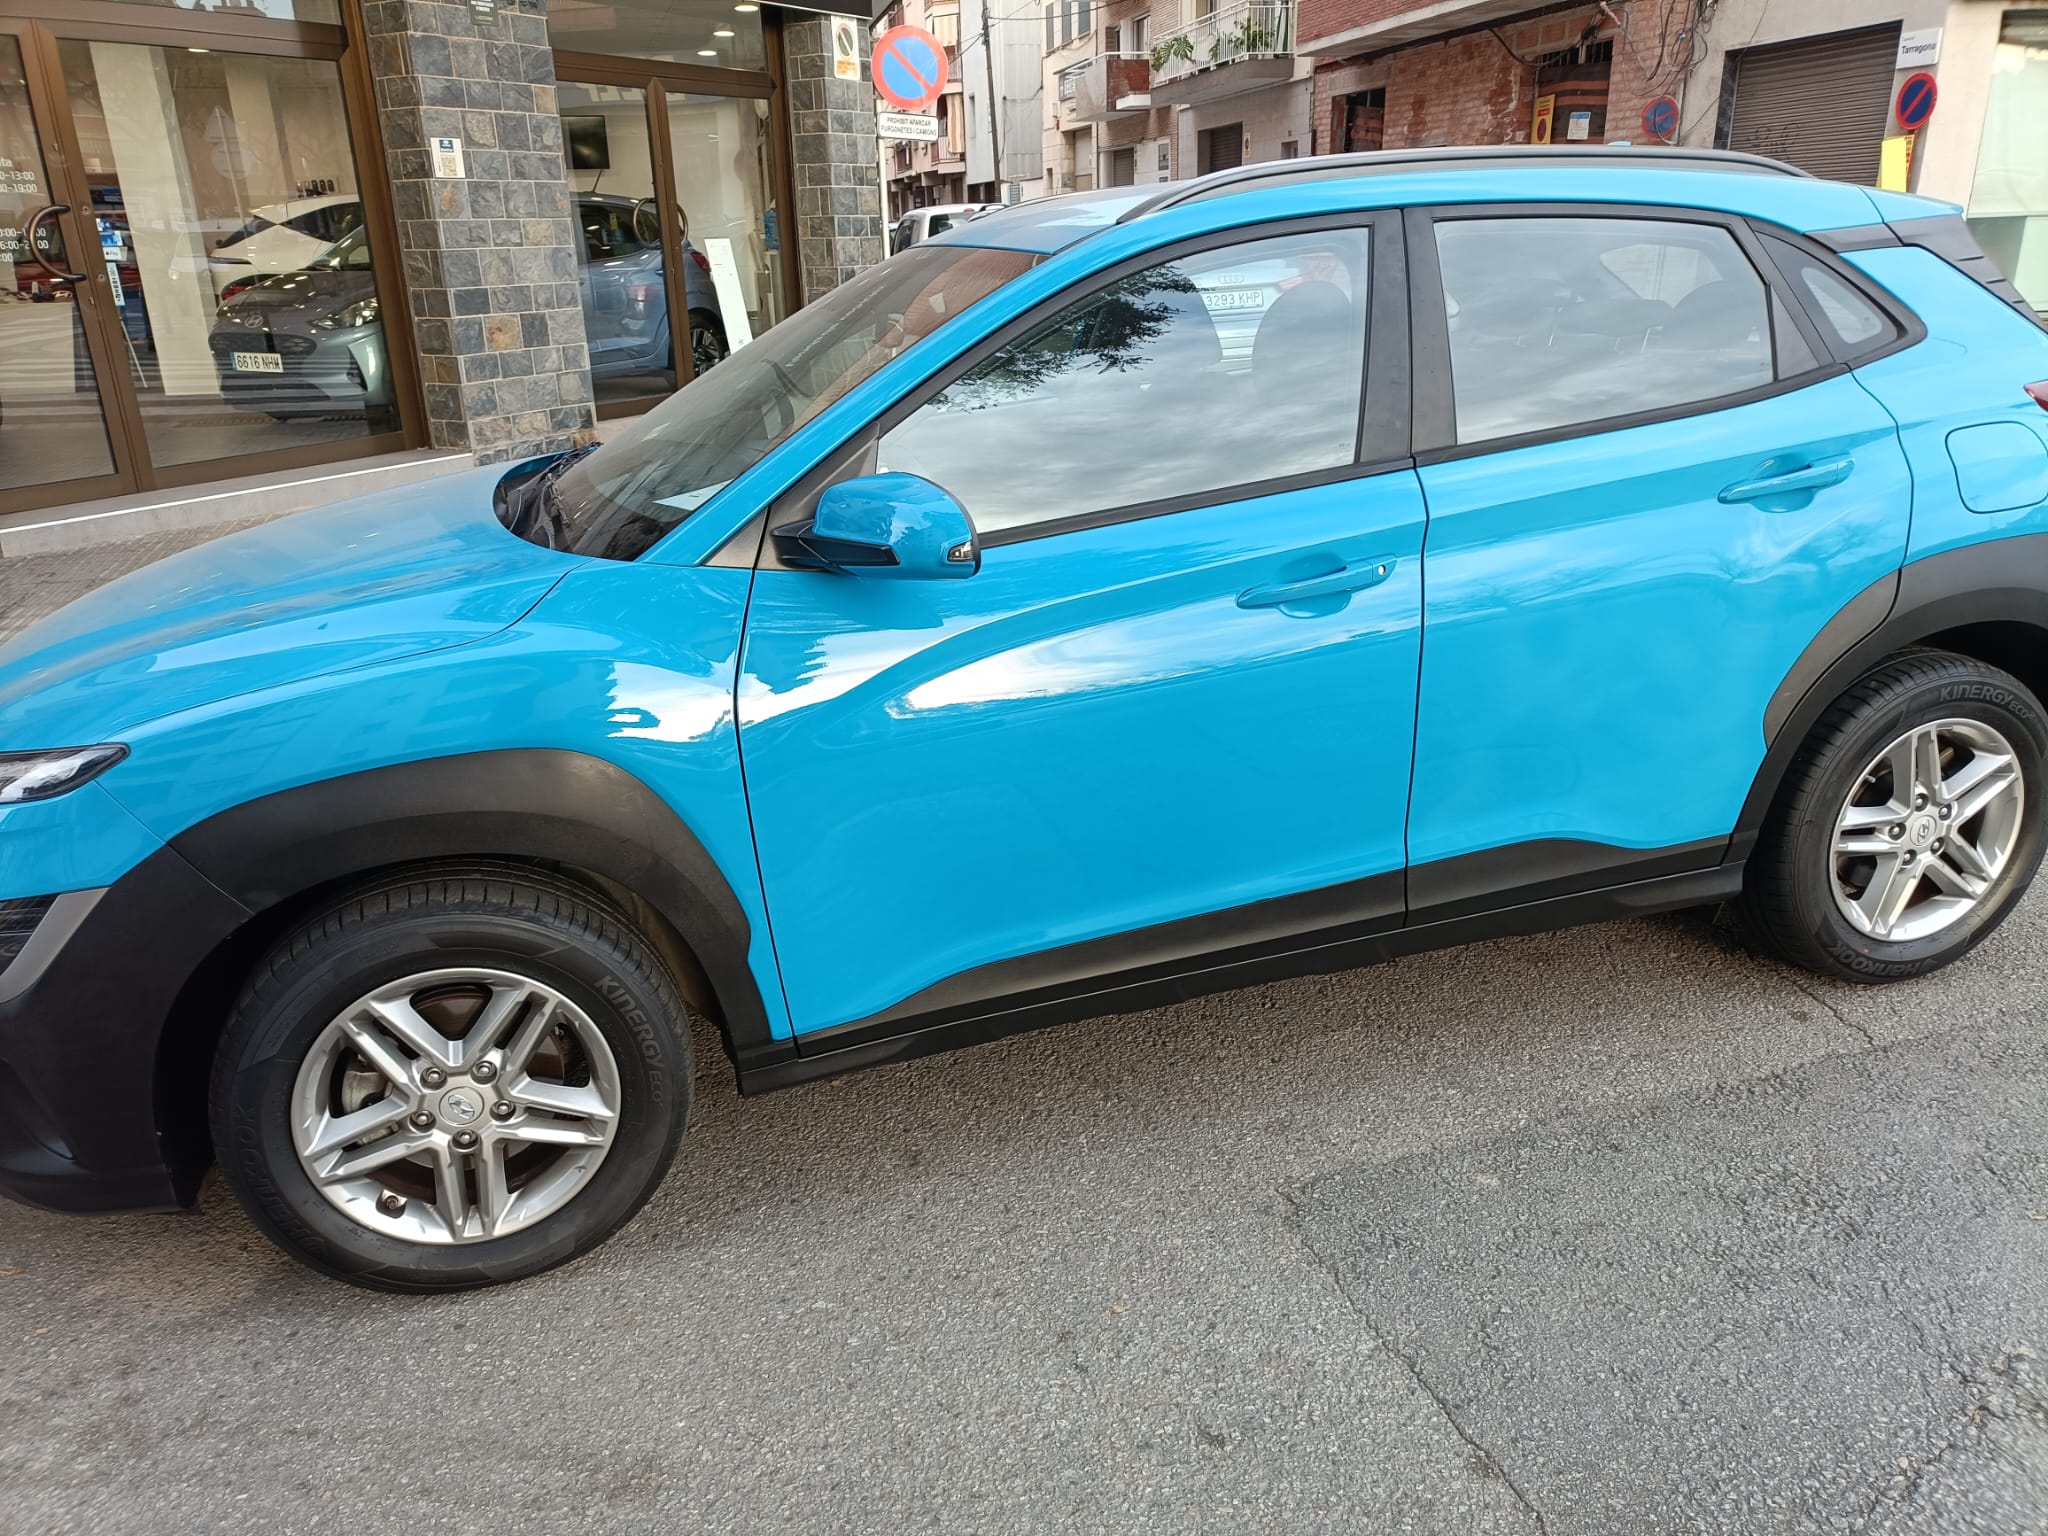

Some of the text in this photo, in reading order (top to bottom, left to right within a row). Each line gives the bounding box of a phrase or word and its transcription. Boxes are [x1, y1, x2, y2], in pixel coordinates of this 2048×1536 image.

[1902, 43, 1936, 54] Tarragona
[887, 117, 931, 127] PROHIBIT APARCAR
[1206, 291, 1260, 307] 3293 KHP
[236, 355, 260, 369] 6616
